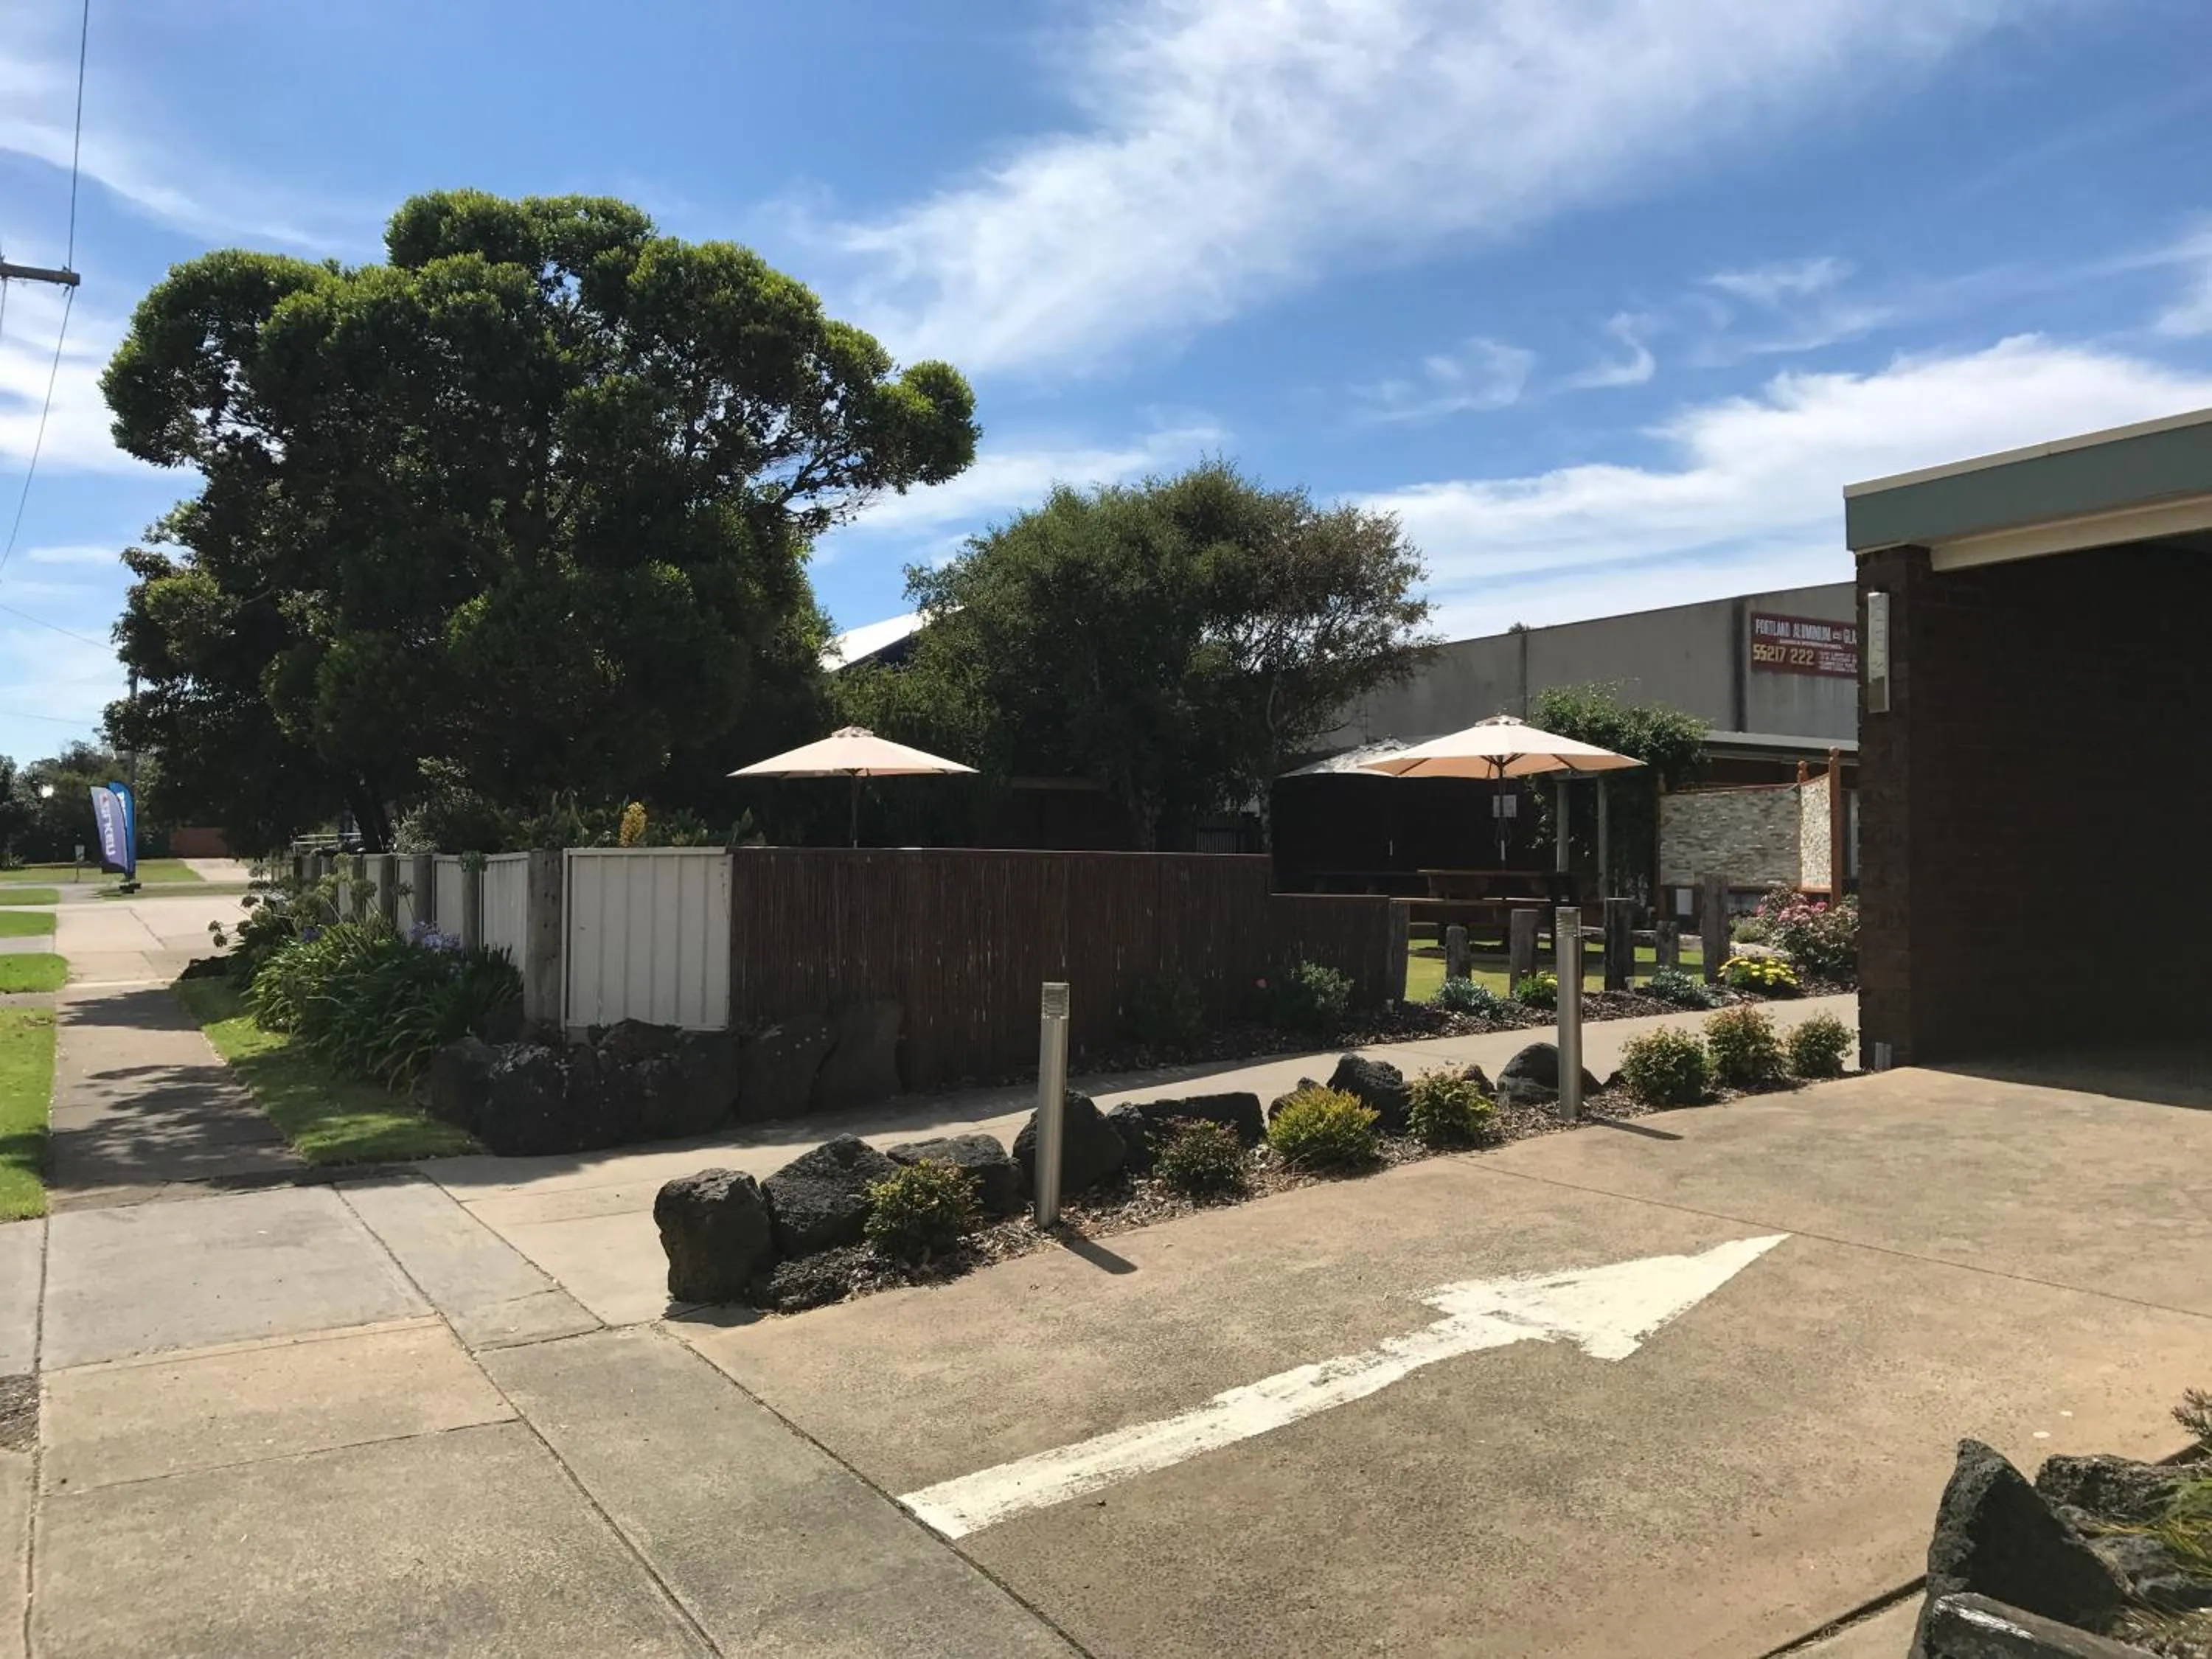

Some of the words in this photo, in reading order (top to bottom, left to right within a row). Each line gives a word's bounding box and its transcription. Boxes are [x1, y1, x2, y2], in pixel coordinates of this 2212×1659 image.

[1756, 619, 1790, 637] PORTLAND
[1843, 628, 1857, 645] GLA
[1790, 648, 1814, 666] 222
